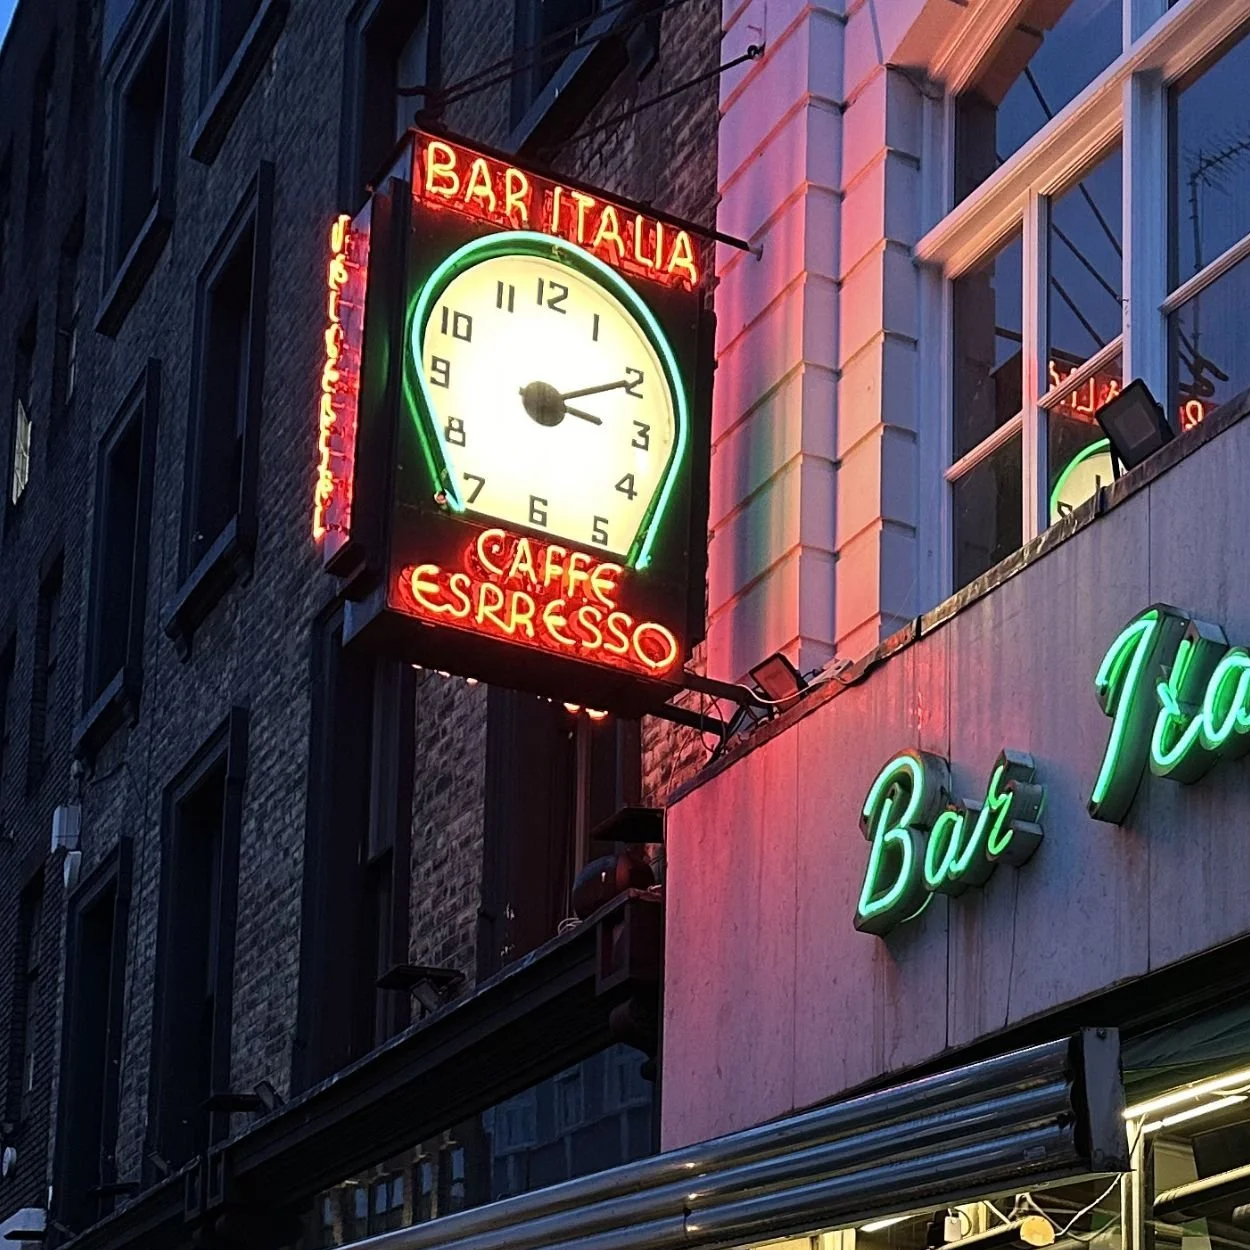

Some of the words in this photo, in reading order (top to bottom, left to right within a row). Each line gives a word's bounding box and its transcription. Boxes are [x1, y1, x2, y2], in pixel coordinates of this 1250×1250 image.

[426, 141, 530, 224] BAR
[551, 186, 699, 287] ITALIA
[495, 281, 515, 313] 11
[537, 277, 569, 314] 12
[441, 305, 473, 342] 10
[591, 313, 600, 342] 1
[430, 356, 451, 389] 9
[624, 366, 645, 399] 2
[444, 415, 467, 448] 8
[631, 421, 651, 451] 3
[463, 472, 487, 504] 7
[614, 473, 638, 501] 4
[528, 495, 548, 527] 6
[591, 516, 609, 546] 5
[476, 528, 624, 610] CAFFE
[855, 750, 1038, 930] Bar
